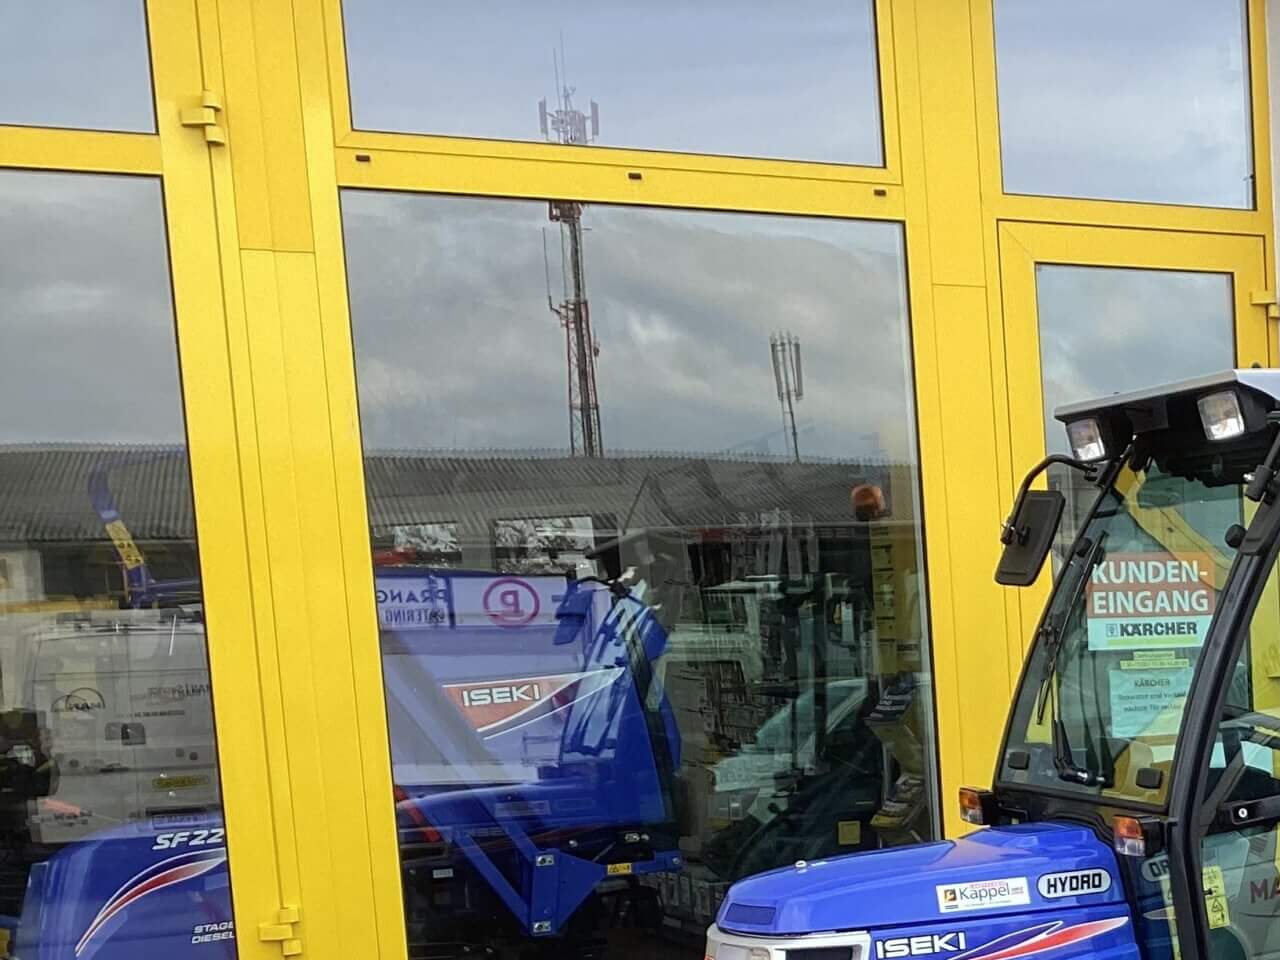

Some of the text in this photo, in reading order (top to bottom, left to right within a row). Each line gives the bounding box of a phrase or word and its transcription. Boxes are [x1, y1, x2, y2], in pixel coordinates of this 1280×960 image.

[1090, 559, 1208, 585] KUNDEN-
[1092, 589, 1209, 614] EINGANG
[1119, 621, 1198, 637] KÄRCHER
[463, 683, 540, 707] ISEKI
[958, 882, 1010, 902] Kappel
[1046, 872, 1103, 895] HYDRO
[191, 931, 236, 945] DIESEL
[876, 931, 967, 960] ISEKI
